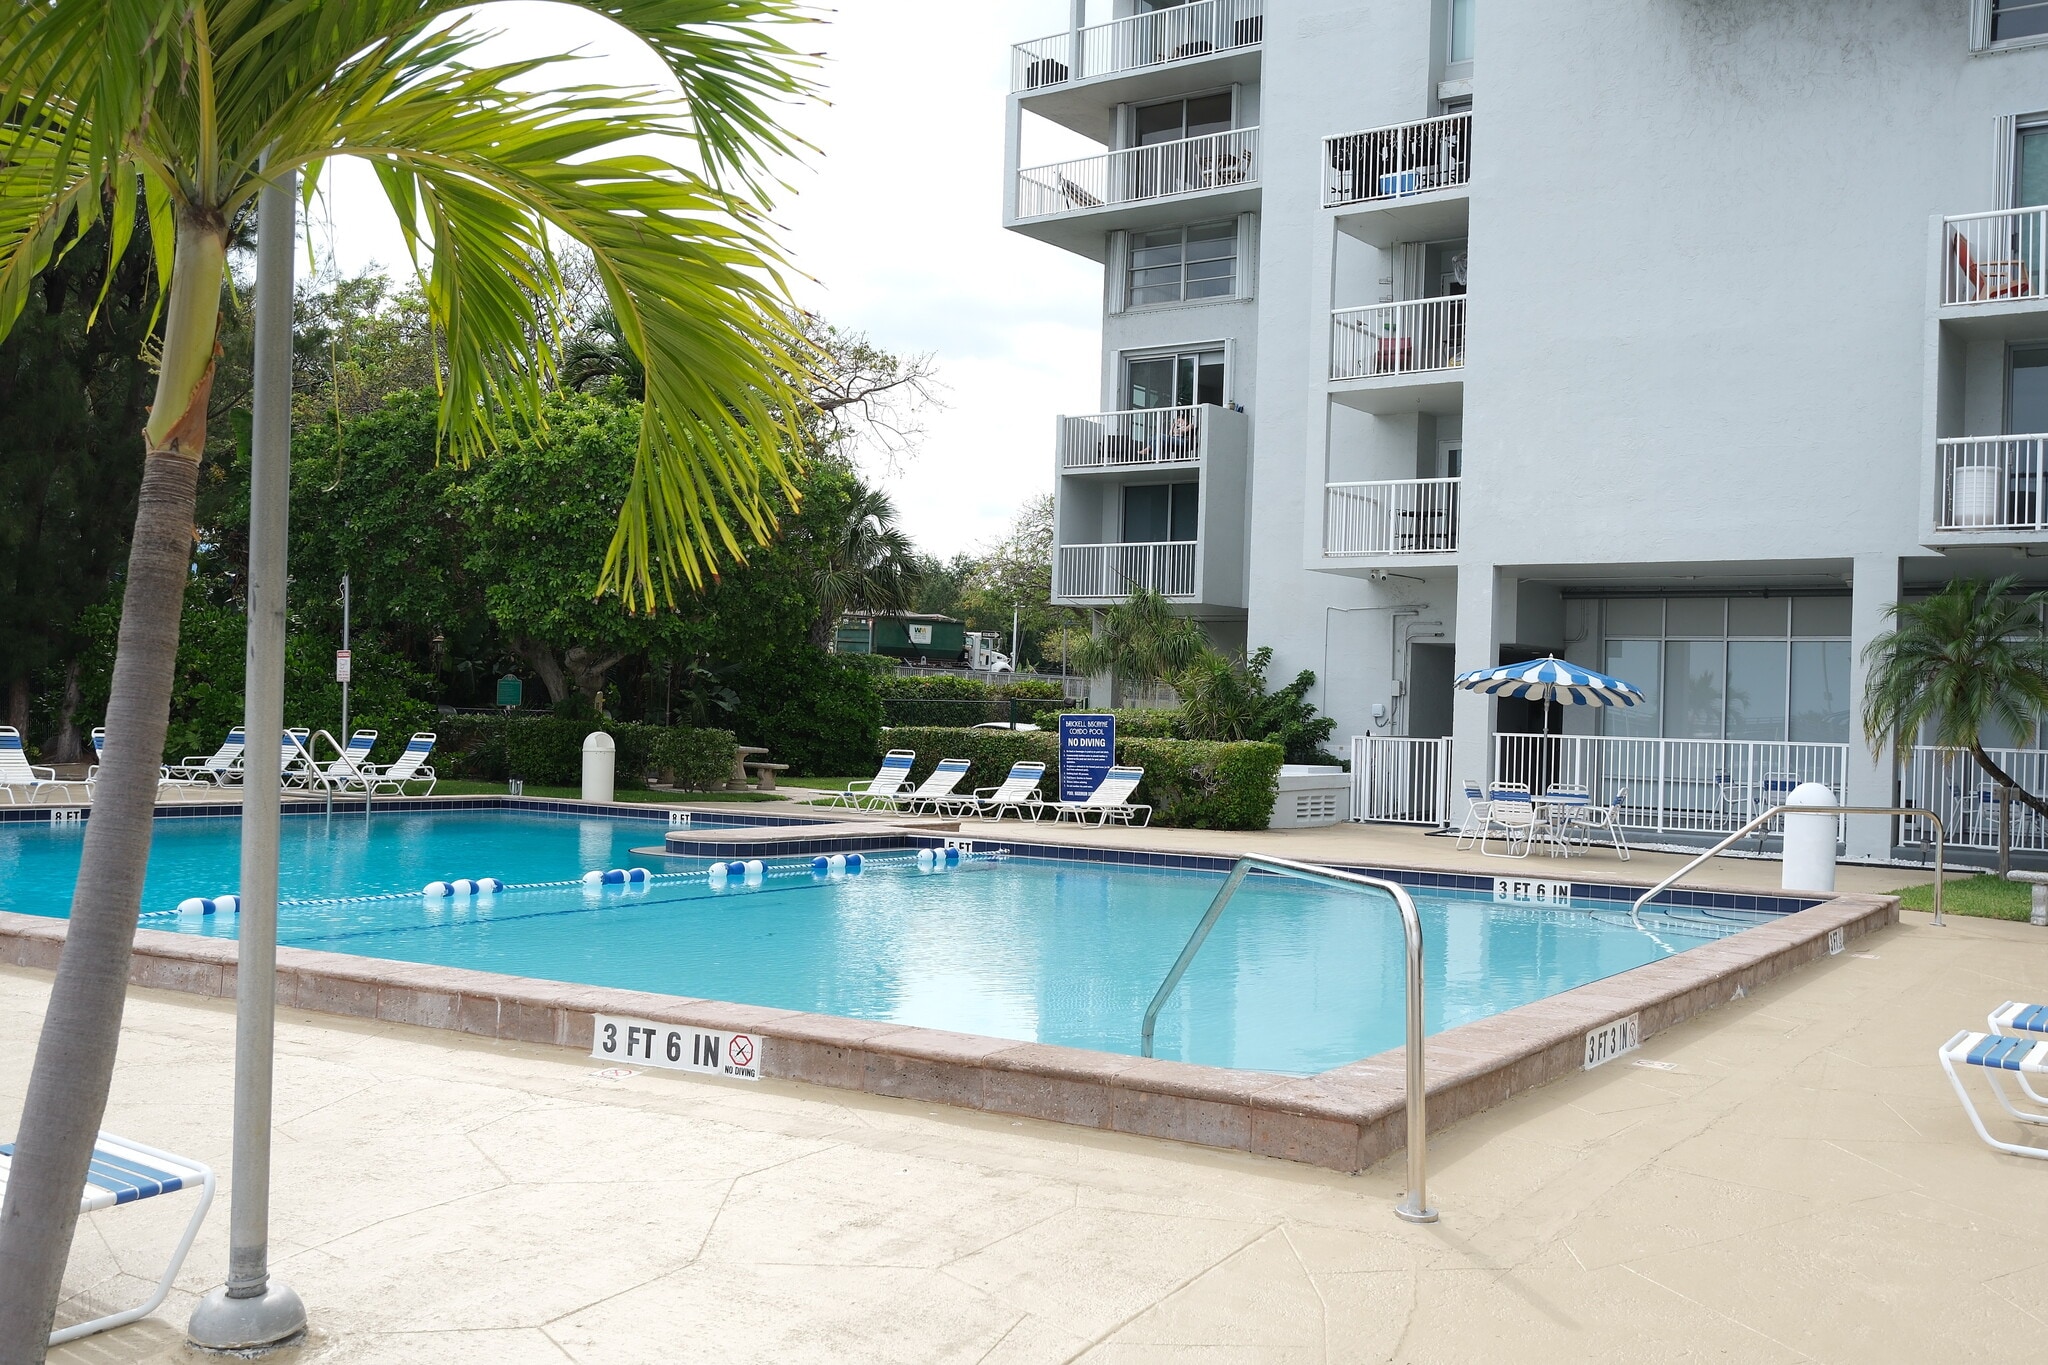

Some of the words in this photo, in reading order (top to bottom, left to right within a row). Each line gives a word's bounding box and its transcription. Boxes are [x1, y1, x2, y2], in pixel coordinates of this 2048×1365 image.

[1068, 738, 1079, 747] NO
[1080, 738, 1106, 748] DIVING
[55, 811, 62, 821] 8
[66, 811, 80, 821] FT
[959, 842, 972, 852] FT
[1499, 881, 1508, 892] 3
[1513, 882, 1531, 894] FT
[1536, 883, 1546, 895] 6
[1553, 884, 1568, 897] IN
[602, 1023, 617, 1053] 3
[627, 1026, 657, 1059] FT
[666, 1031, 682, 1062] 6
[693, 1034, 720, 1068] IN
[1589, 1035, 1595, 1063] 3
[1597, 1030, 1608, 1061] FT
[1610, 1027, 1616, 1054] 3
[1619, 1021, 1628, 1051] IN
[724, 1065, 733, 1075] NO
[734, 1066, 756, 1078] DIVING
